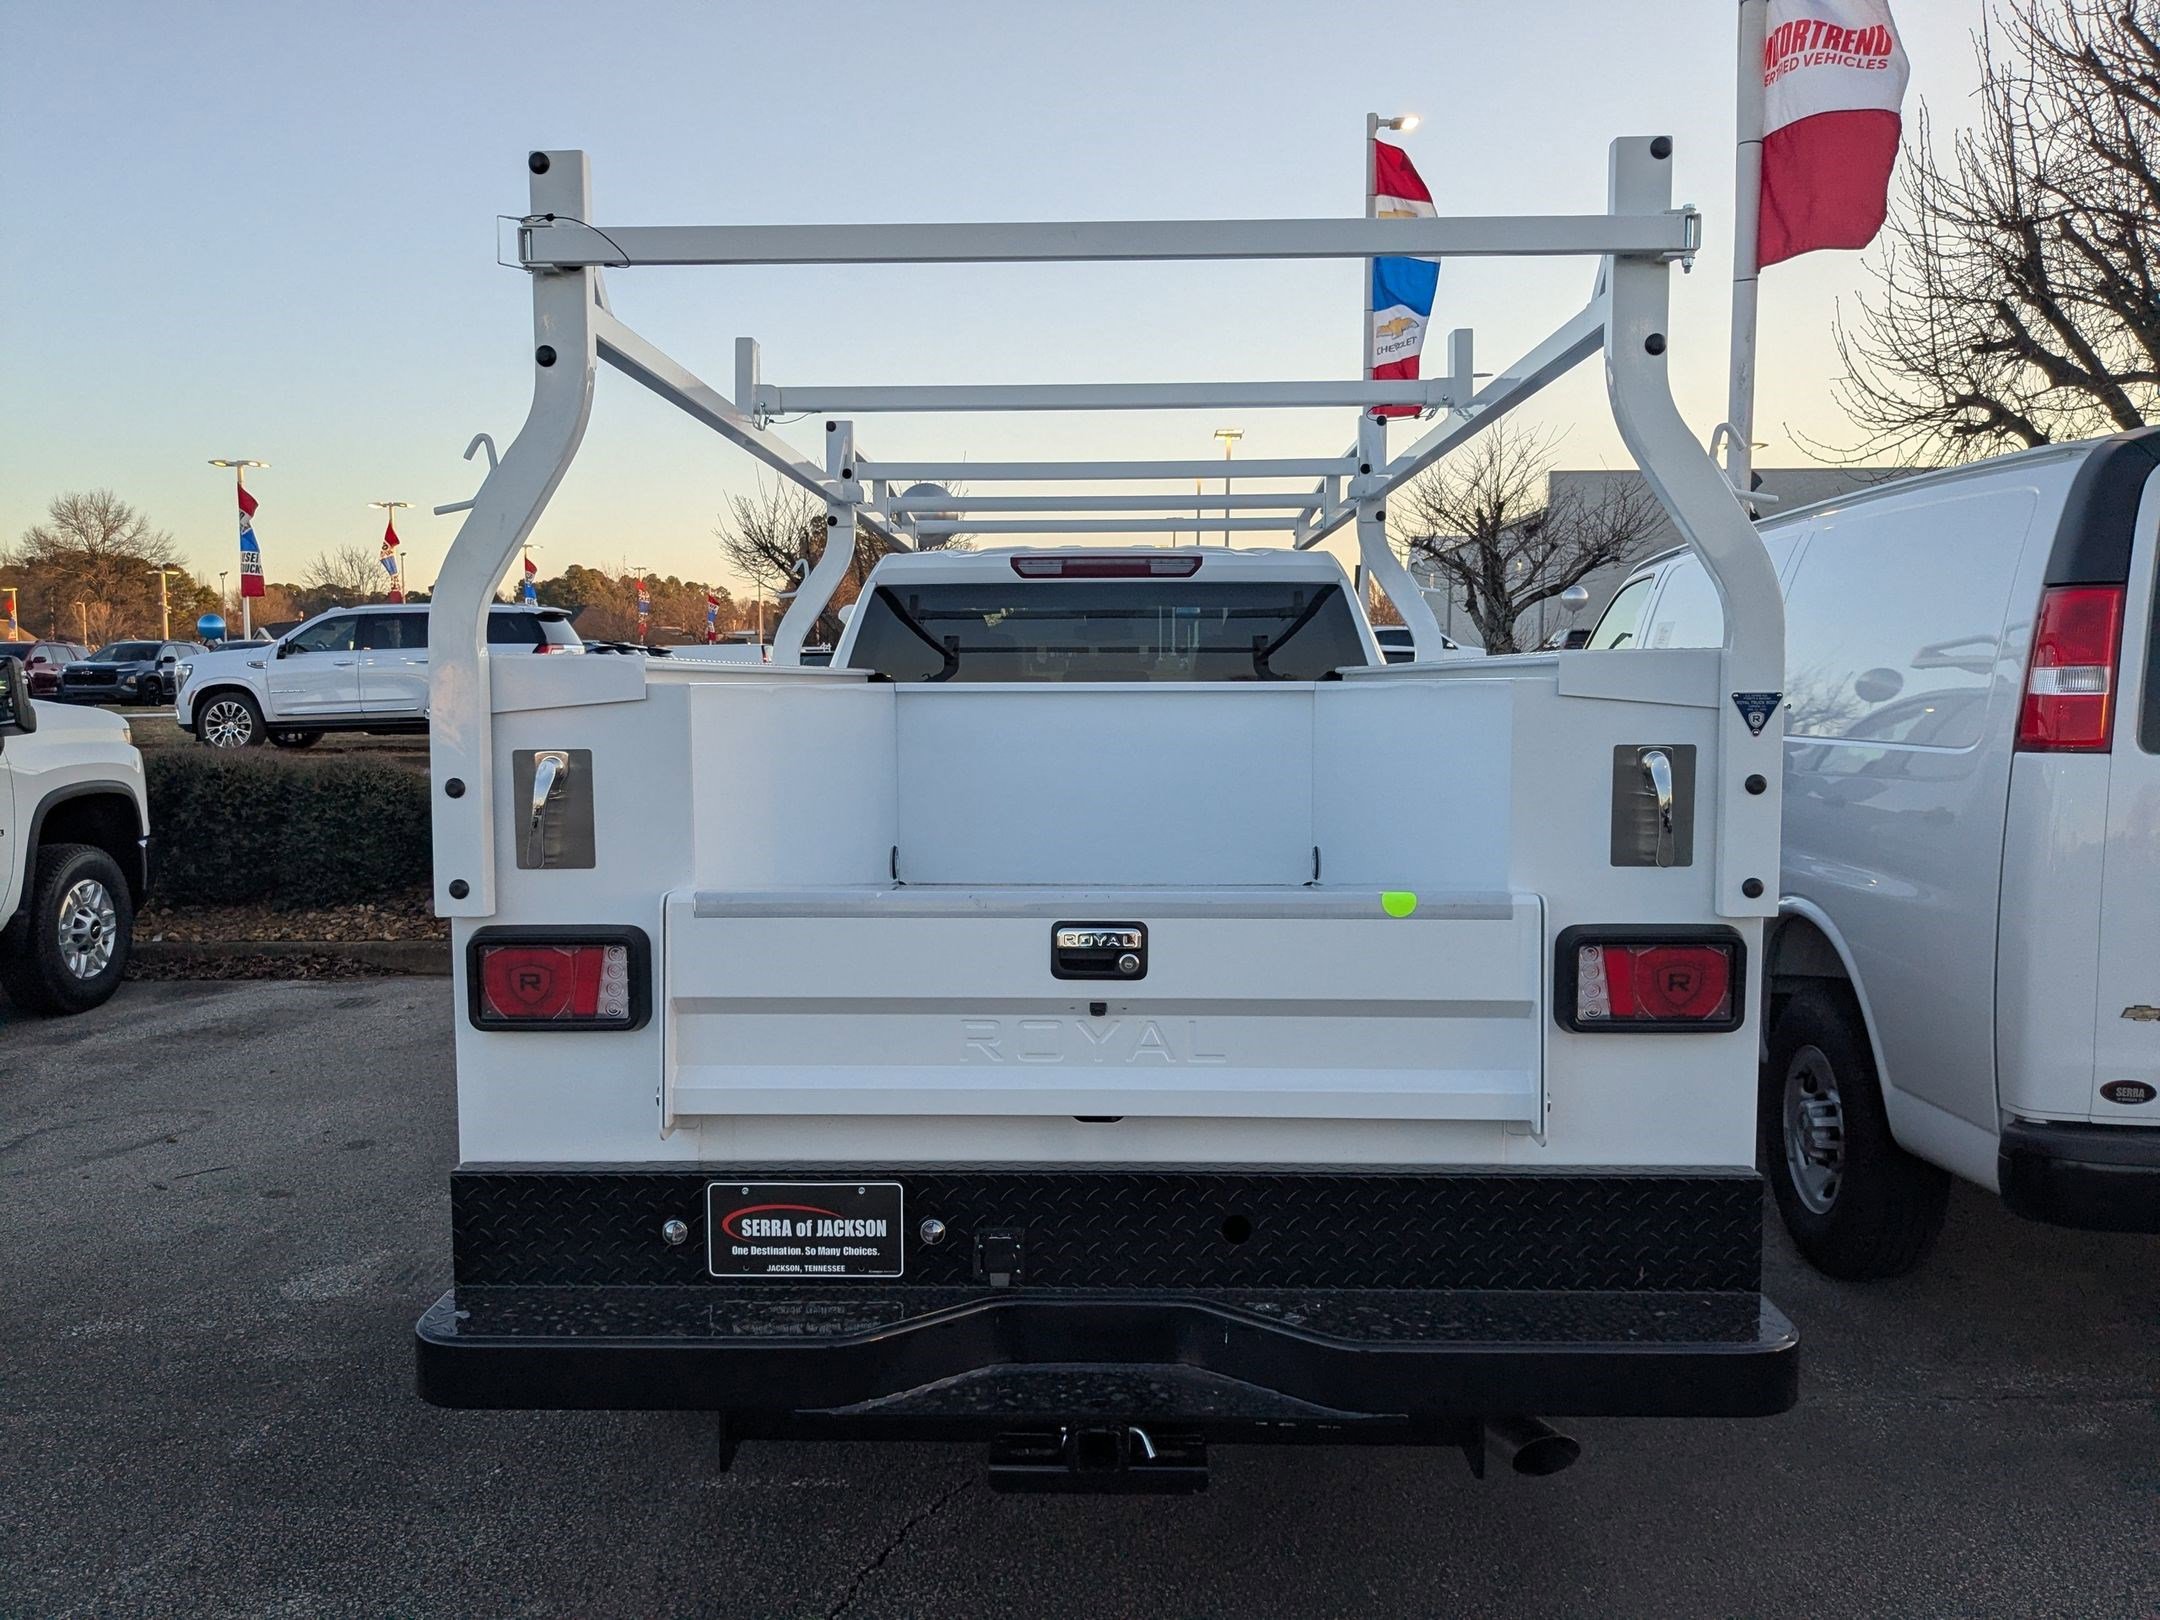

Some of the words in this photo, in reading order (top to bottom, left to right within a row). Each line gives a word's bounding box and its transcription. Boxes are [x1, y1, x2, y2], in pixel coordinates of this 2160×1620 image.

[1804, 52, 1888, 70] VEHICLES
[1063, 933, 1137, 947] ROYAL
[960, 1019, 1226, 1063] ROYAL
[2115, 1087, 2145, 1098] SERRA
[741, 1218, 792, 1237] SERRA
[796, 1219, 813, 1237] of
[816, 1219, 887, 1237] JACKSON
[732, 1246, 749, 1256] One
[750, 1246, 804, 1256] Destination.
[805, 1246, 817, 1256] So
[818, 1247, 841, 1257] Many
[843, 1246, 881, 1256] Choices.
[767, 1264, 802, 1273] JACKSON,
[804, 1264, 846, 1273] TENNESSEE
